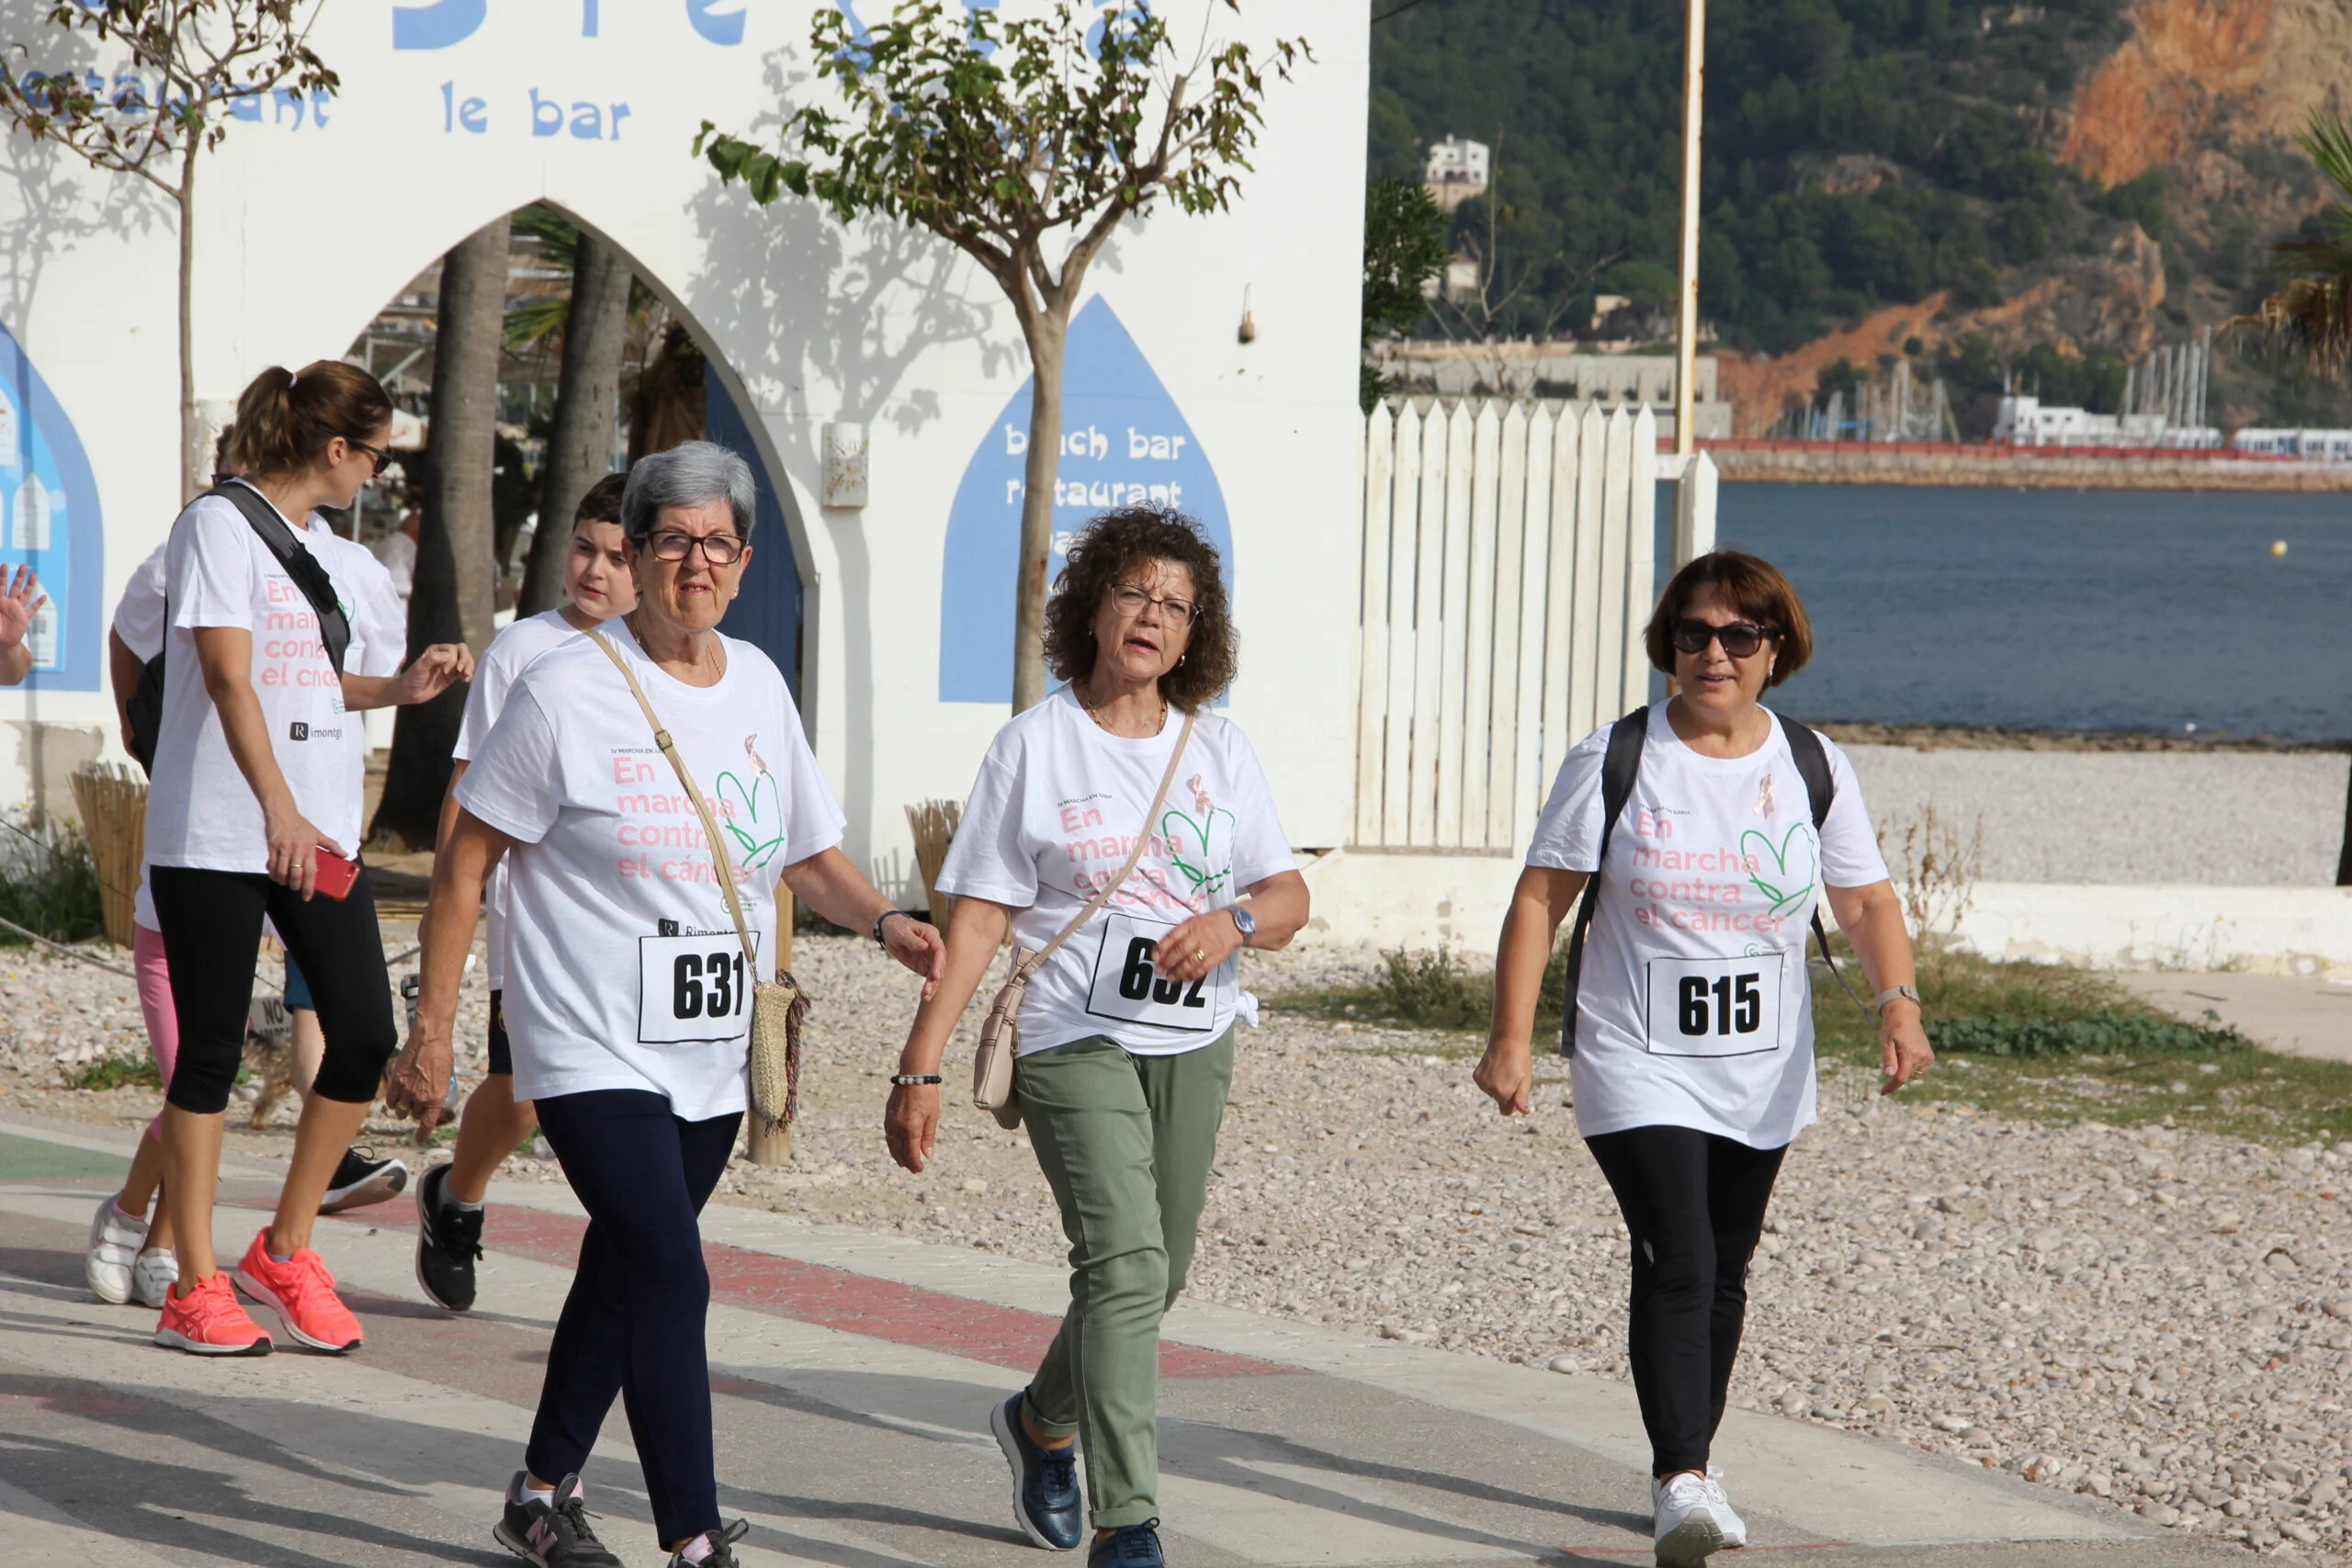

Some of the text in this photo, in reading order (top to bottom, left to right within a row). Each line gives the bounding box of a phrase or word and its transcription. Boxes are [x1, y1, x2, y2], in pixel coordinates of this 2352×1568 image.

[441, 79, 631, 141] le bar
[1005, 423, 1185, 461] bch bar
[1006, 477, 1182, 508] rtaurant
[267, 581, 298, 603] En
[261, 662, 288, 686] el
[613, 757, 656, 784] En
[1060, 806, 1103, 834] En
[1636, 809, 1673, 839] En
[617, 852, 650, 879] el
[1633, 847, 1761, 874] marcha
[1630, 877, 1742, 904] contra
[1634, 903, 1787, 934] el cáncer
[673, 951, 743, 1020] 631
[1678, 972, 1761, 1036] 615
